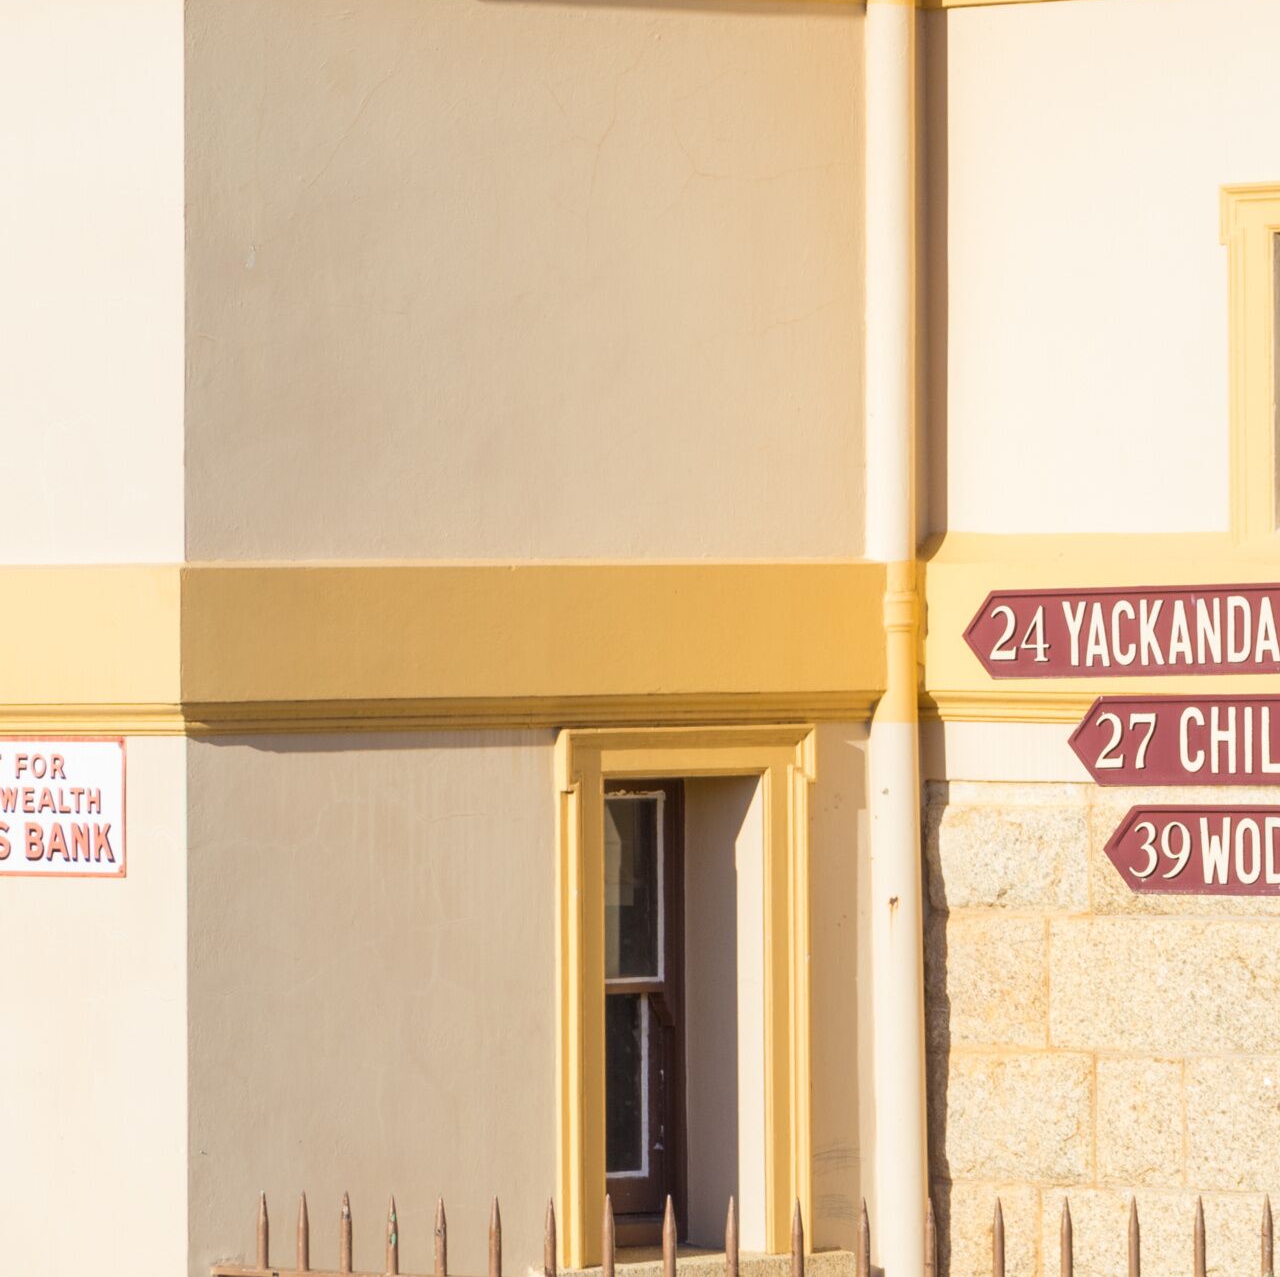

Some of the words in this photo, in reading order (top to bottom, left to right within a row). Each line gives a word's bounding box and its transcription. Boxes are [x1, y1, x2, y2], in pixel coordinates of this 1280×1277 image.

[988, 604, 1050, 663] 24
[15, 752, 67, 780] FOR
[1094, 711, 1158, 771] 27
[25, 821, 116, 863] BANK
[1128, 821, 1193, 879] 39
